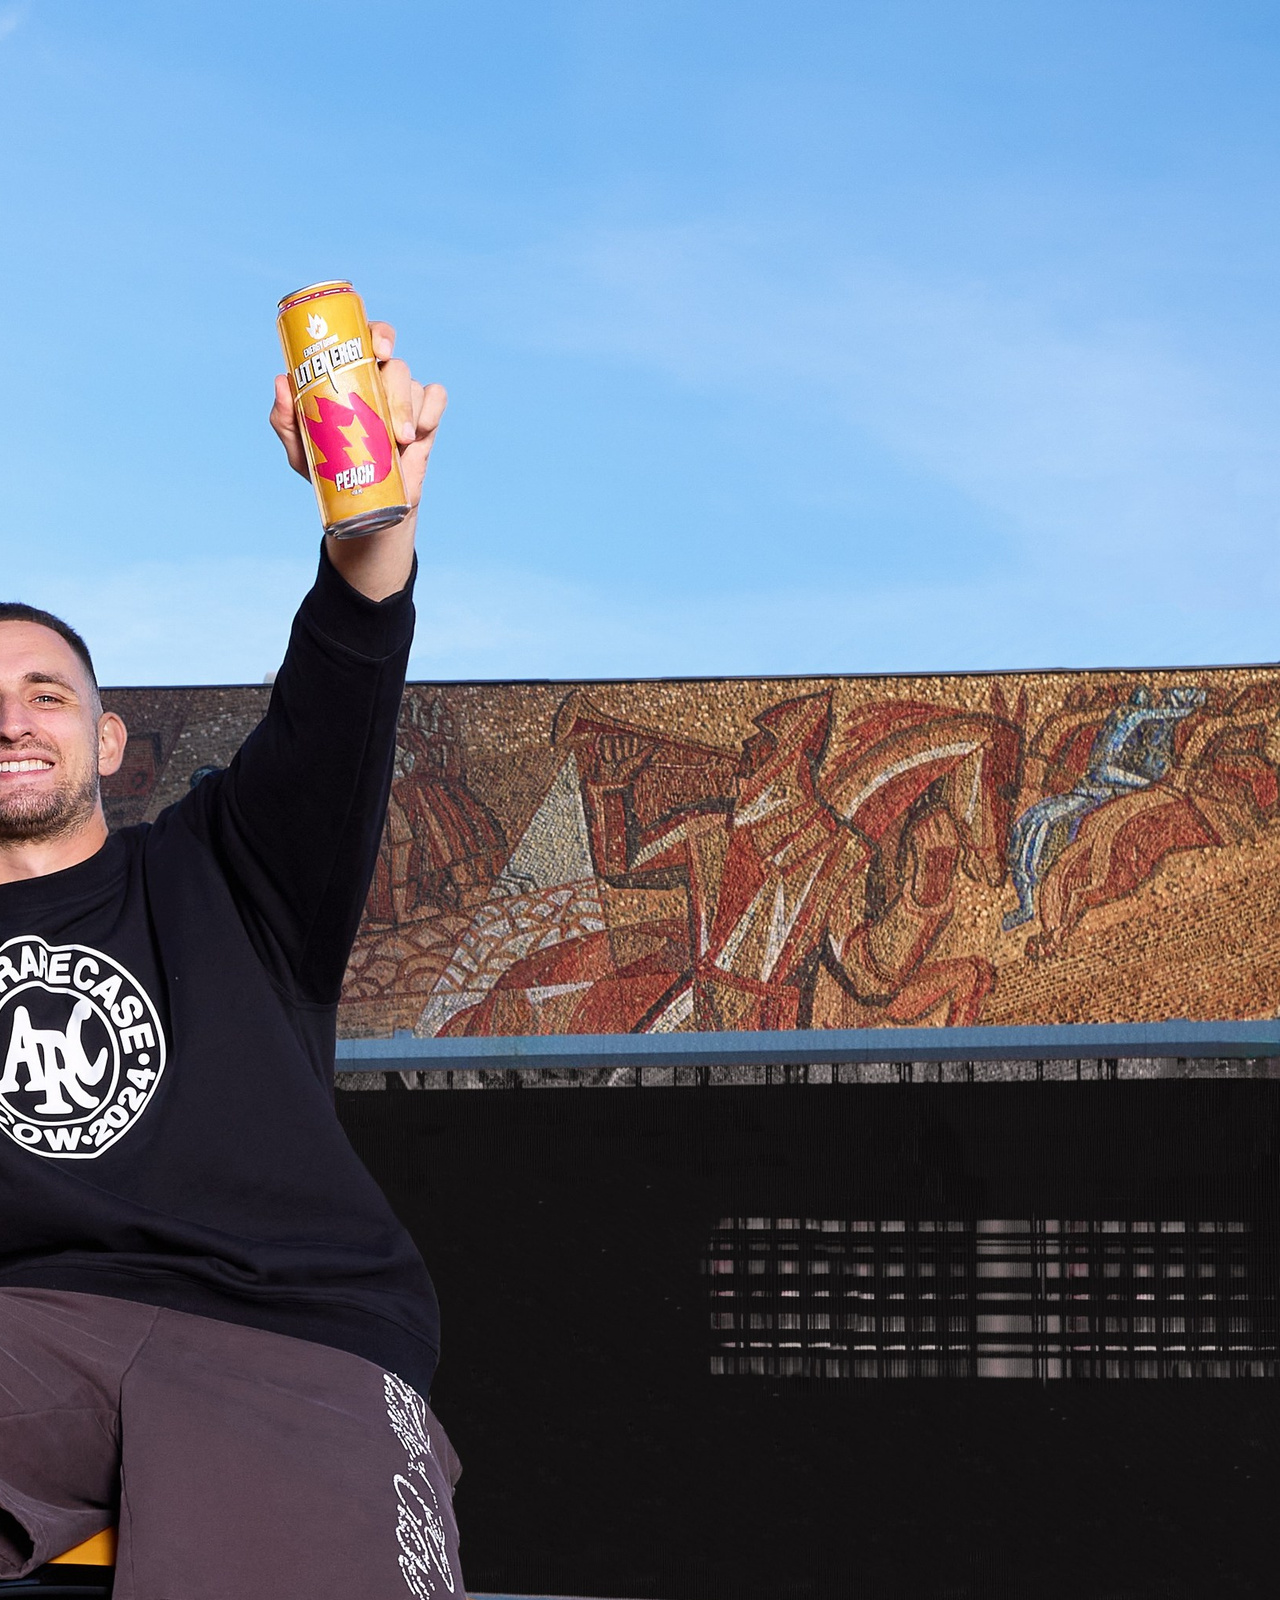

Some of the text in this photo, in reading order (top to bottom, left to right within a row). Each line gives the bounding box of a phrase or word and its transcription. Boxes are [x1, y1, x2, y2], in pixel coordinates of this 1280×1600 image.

[294, 337, 364, 394] LIT ENERGY
[335, 463, 375, 492] PEACH
[73, 956, 156, 1055] CASE
[88, 1067, 157, 1148] 2024
